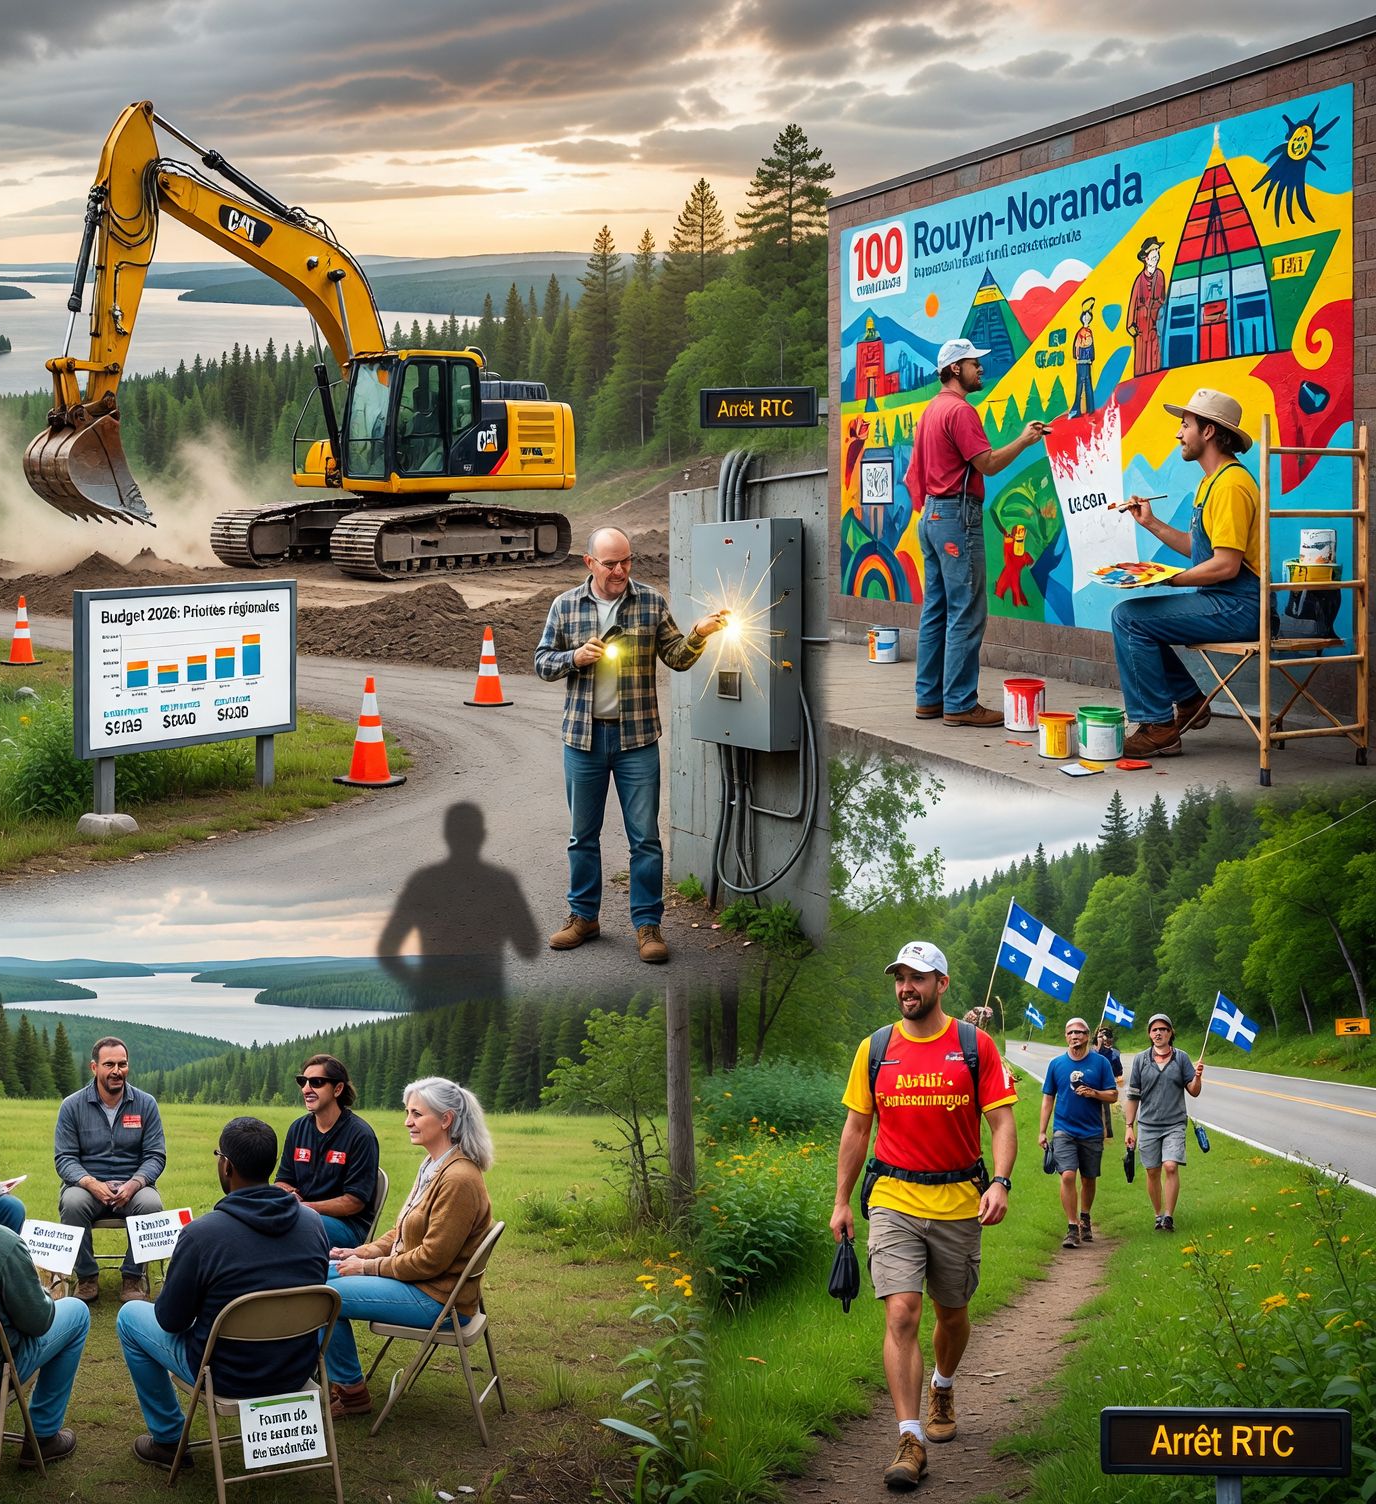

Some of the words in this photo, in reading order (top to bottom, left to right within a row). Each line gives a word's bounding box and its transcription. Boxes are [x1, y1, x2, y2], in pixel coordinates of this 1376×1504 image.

[914, 164, 1143, 259] Rouyn-Noranda
[853, 226, 903, 281] 100
[760, 399, 794, 417] RTC
[101, 608, 145, 626] Budget
[147, 606, 181, 621] 2026:
[1150, 1421, 1222, 1457] Arrêt
[1231, 1424, 1295, 1457] RTC
